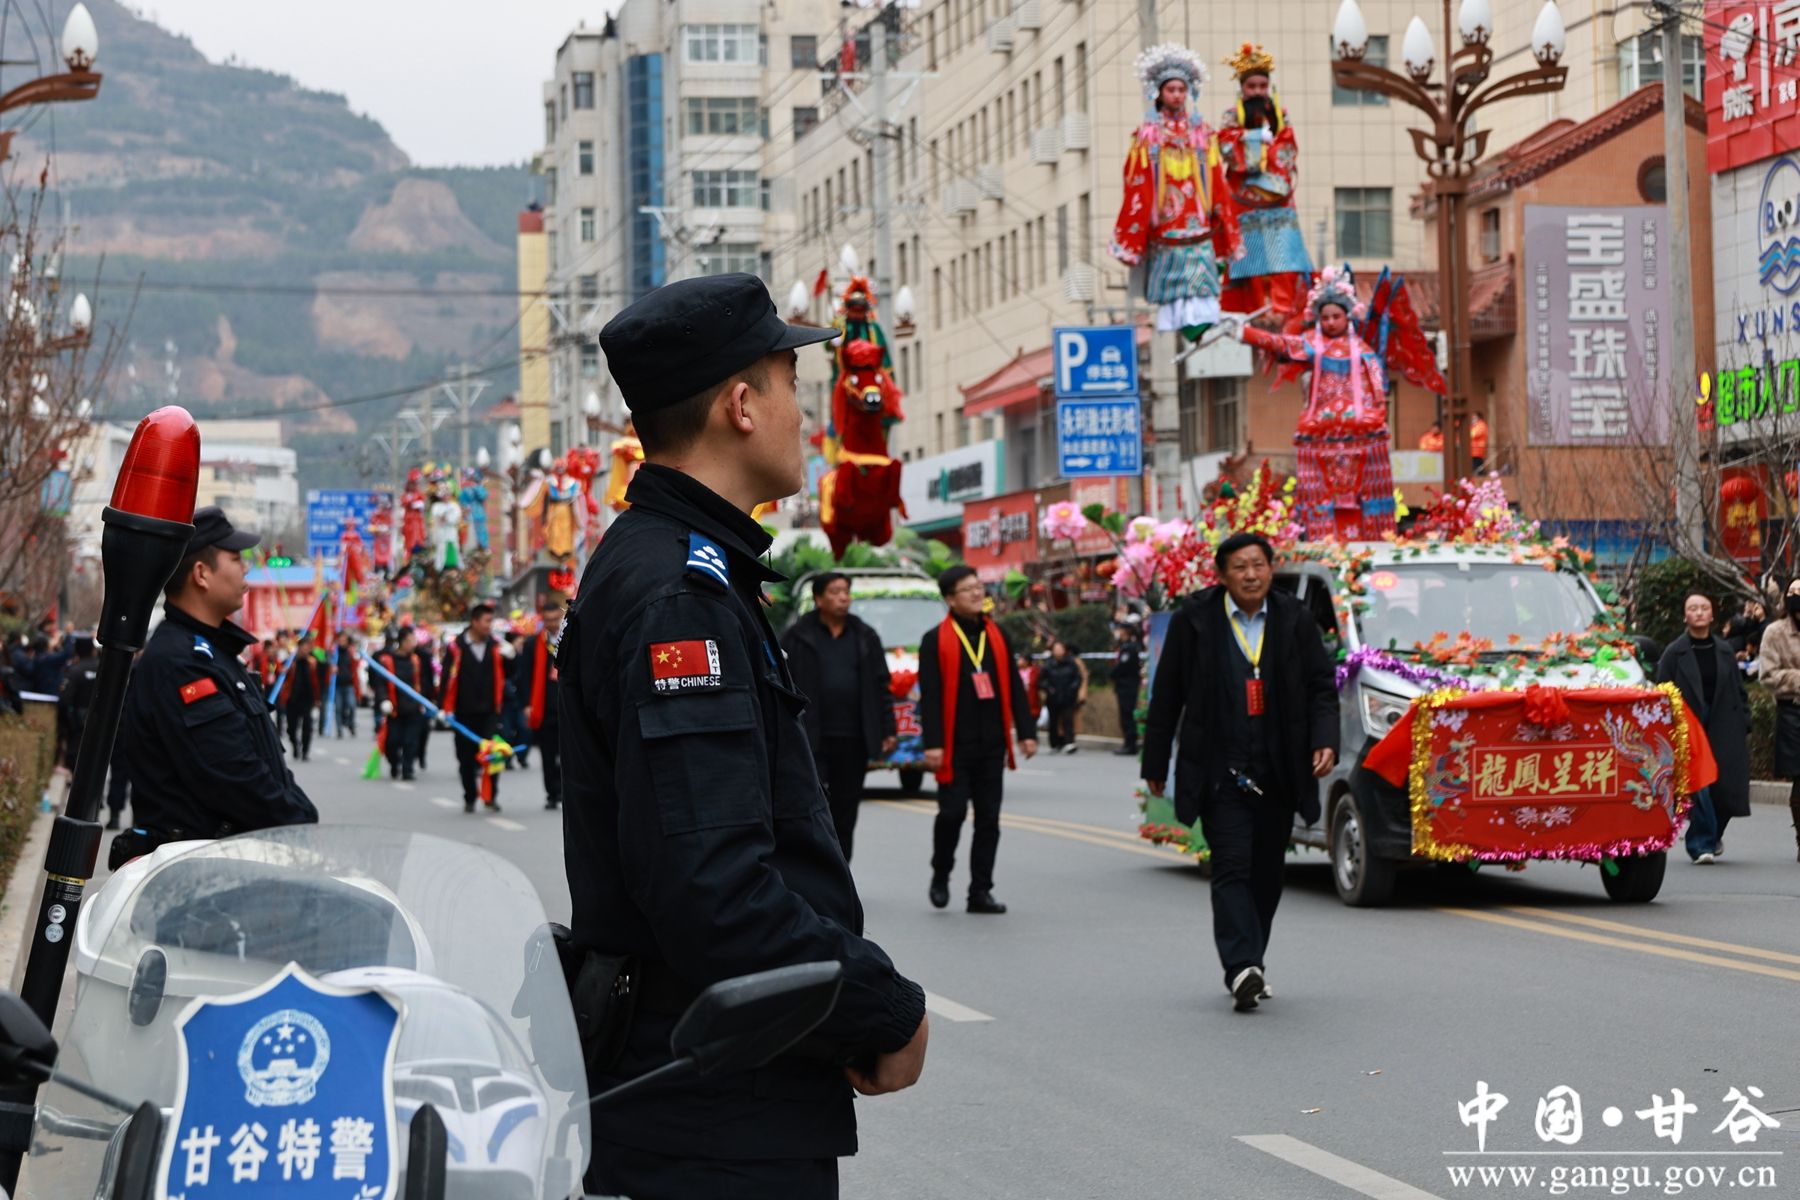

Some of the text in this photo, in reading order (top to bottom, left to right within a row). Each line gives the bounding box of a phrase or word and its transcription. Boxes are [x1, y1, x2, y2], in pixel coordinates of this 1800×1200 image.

[1566, 213, 1628, 438] 宝盛珠宝
[1059, 333, 1088, 392] P
[1087, 364, 1128, 380] 停车场
[708, 641, 719, 674] SWAT
[655, 675, 721, 691] 特警 CHINESE
[1475, 748, 1617, 797] 龍鳳呈祥
[180, 1116, 375, 1188] 甘谷特警
